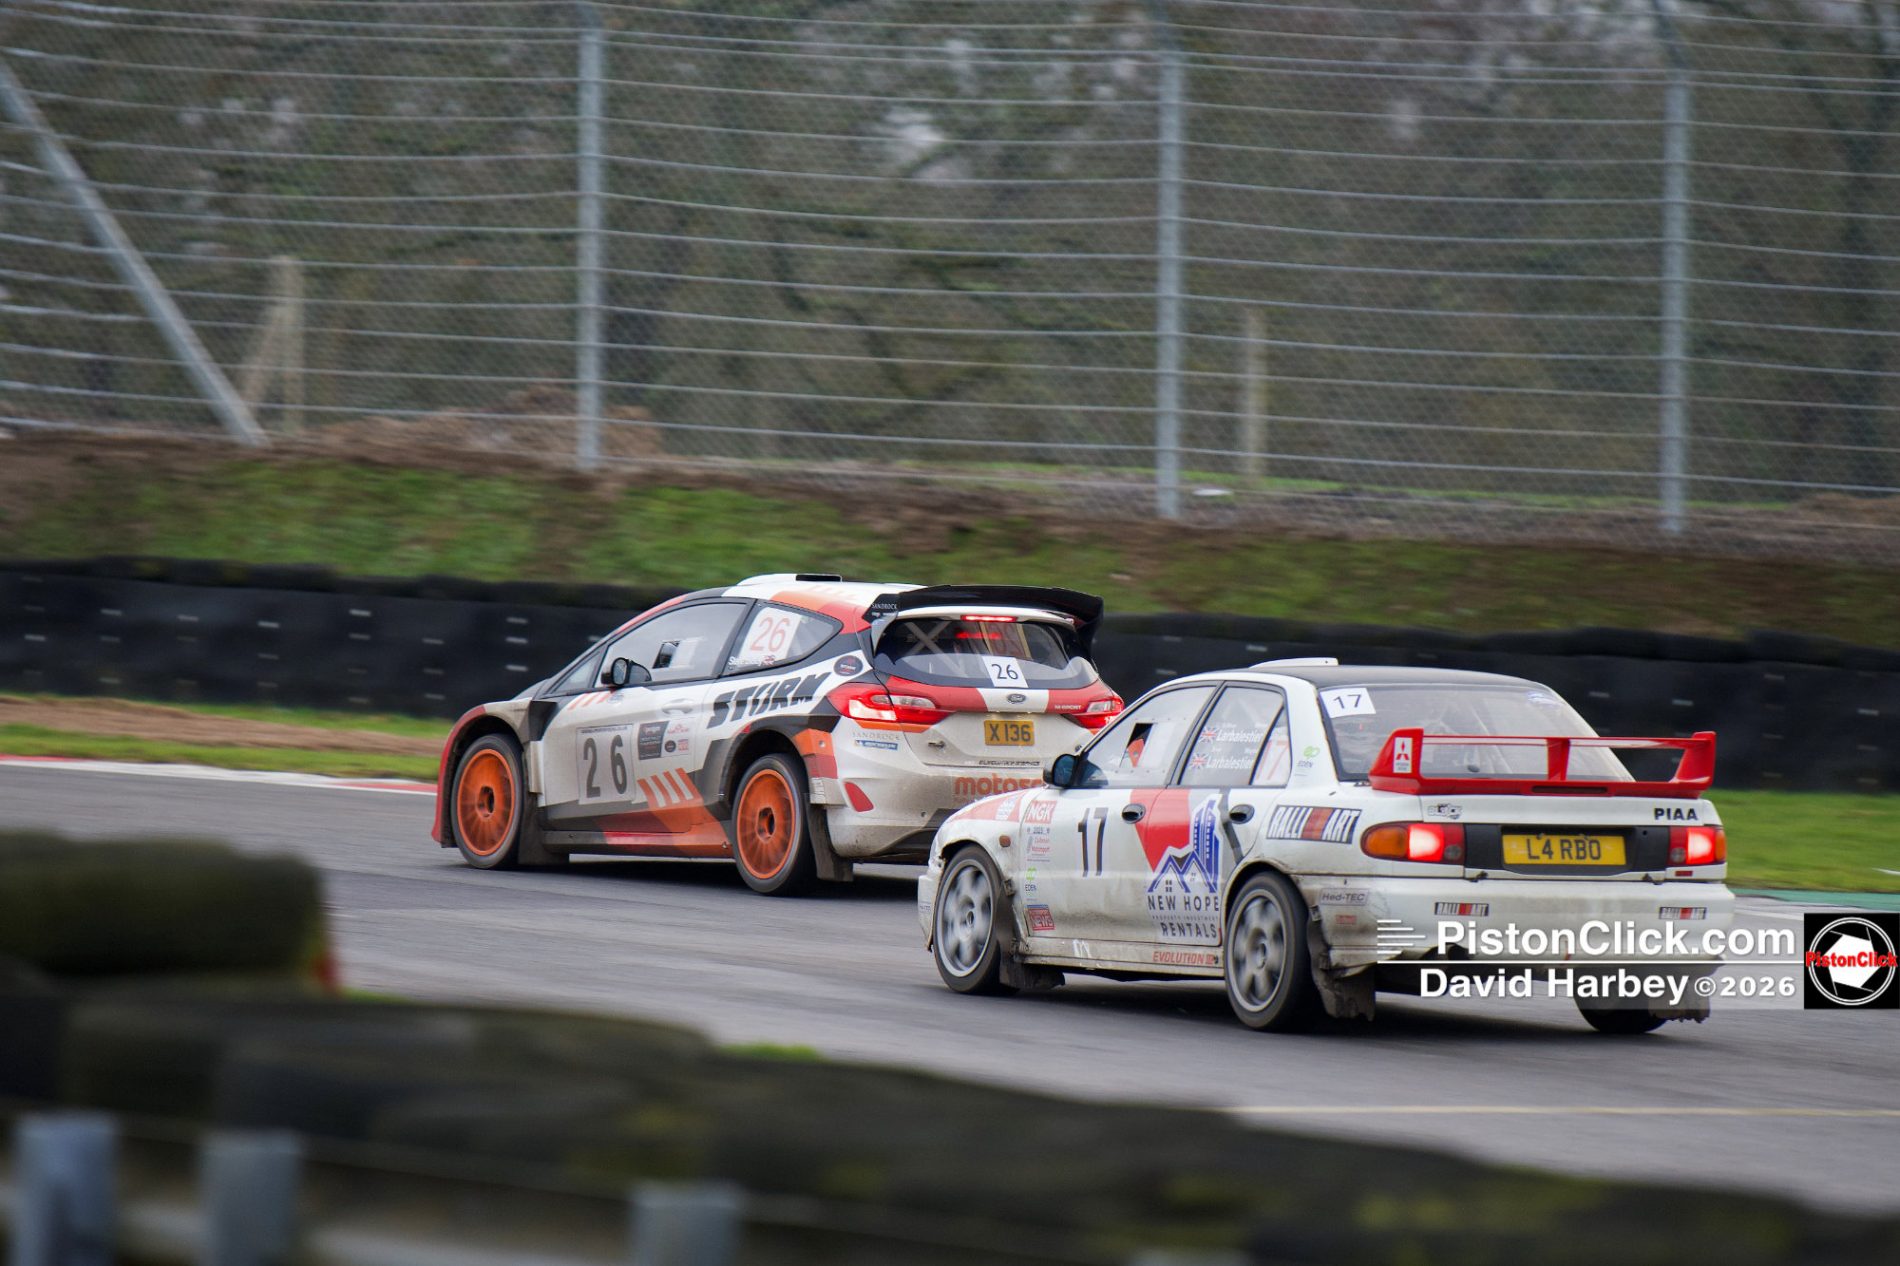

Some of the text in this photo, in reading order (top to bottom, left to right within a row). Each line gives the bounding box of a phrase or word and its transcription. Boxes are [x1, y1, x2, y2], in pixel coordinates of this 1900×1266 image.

[750, 616, 790, 652] 26
[991, 663, 1019, 680] 26
[706, 672, 832, 729] STORM
[1333, 694, 1361, 709] 17
[989, 723, 1031, 742] X 136
[583, 734, 628, 798] 26
[1654, 808, 1698, 821] PIAA
[1077, 806, 1109, 878] 17
[1526, 838, 1554, 860] L4
[1148, 895, 1219, 911] NEW HOPE
[1321, 893, 1366, 901] Hed-TEC
[1160, 922, 1217, 938] RENTALS
[1152, 951, 1205, 965] EVOLUTION
